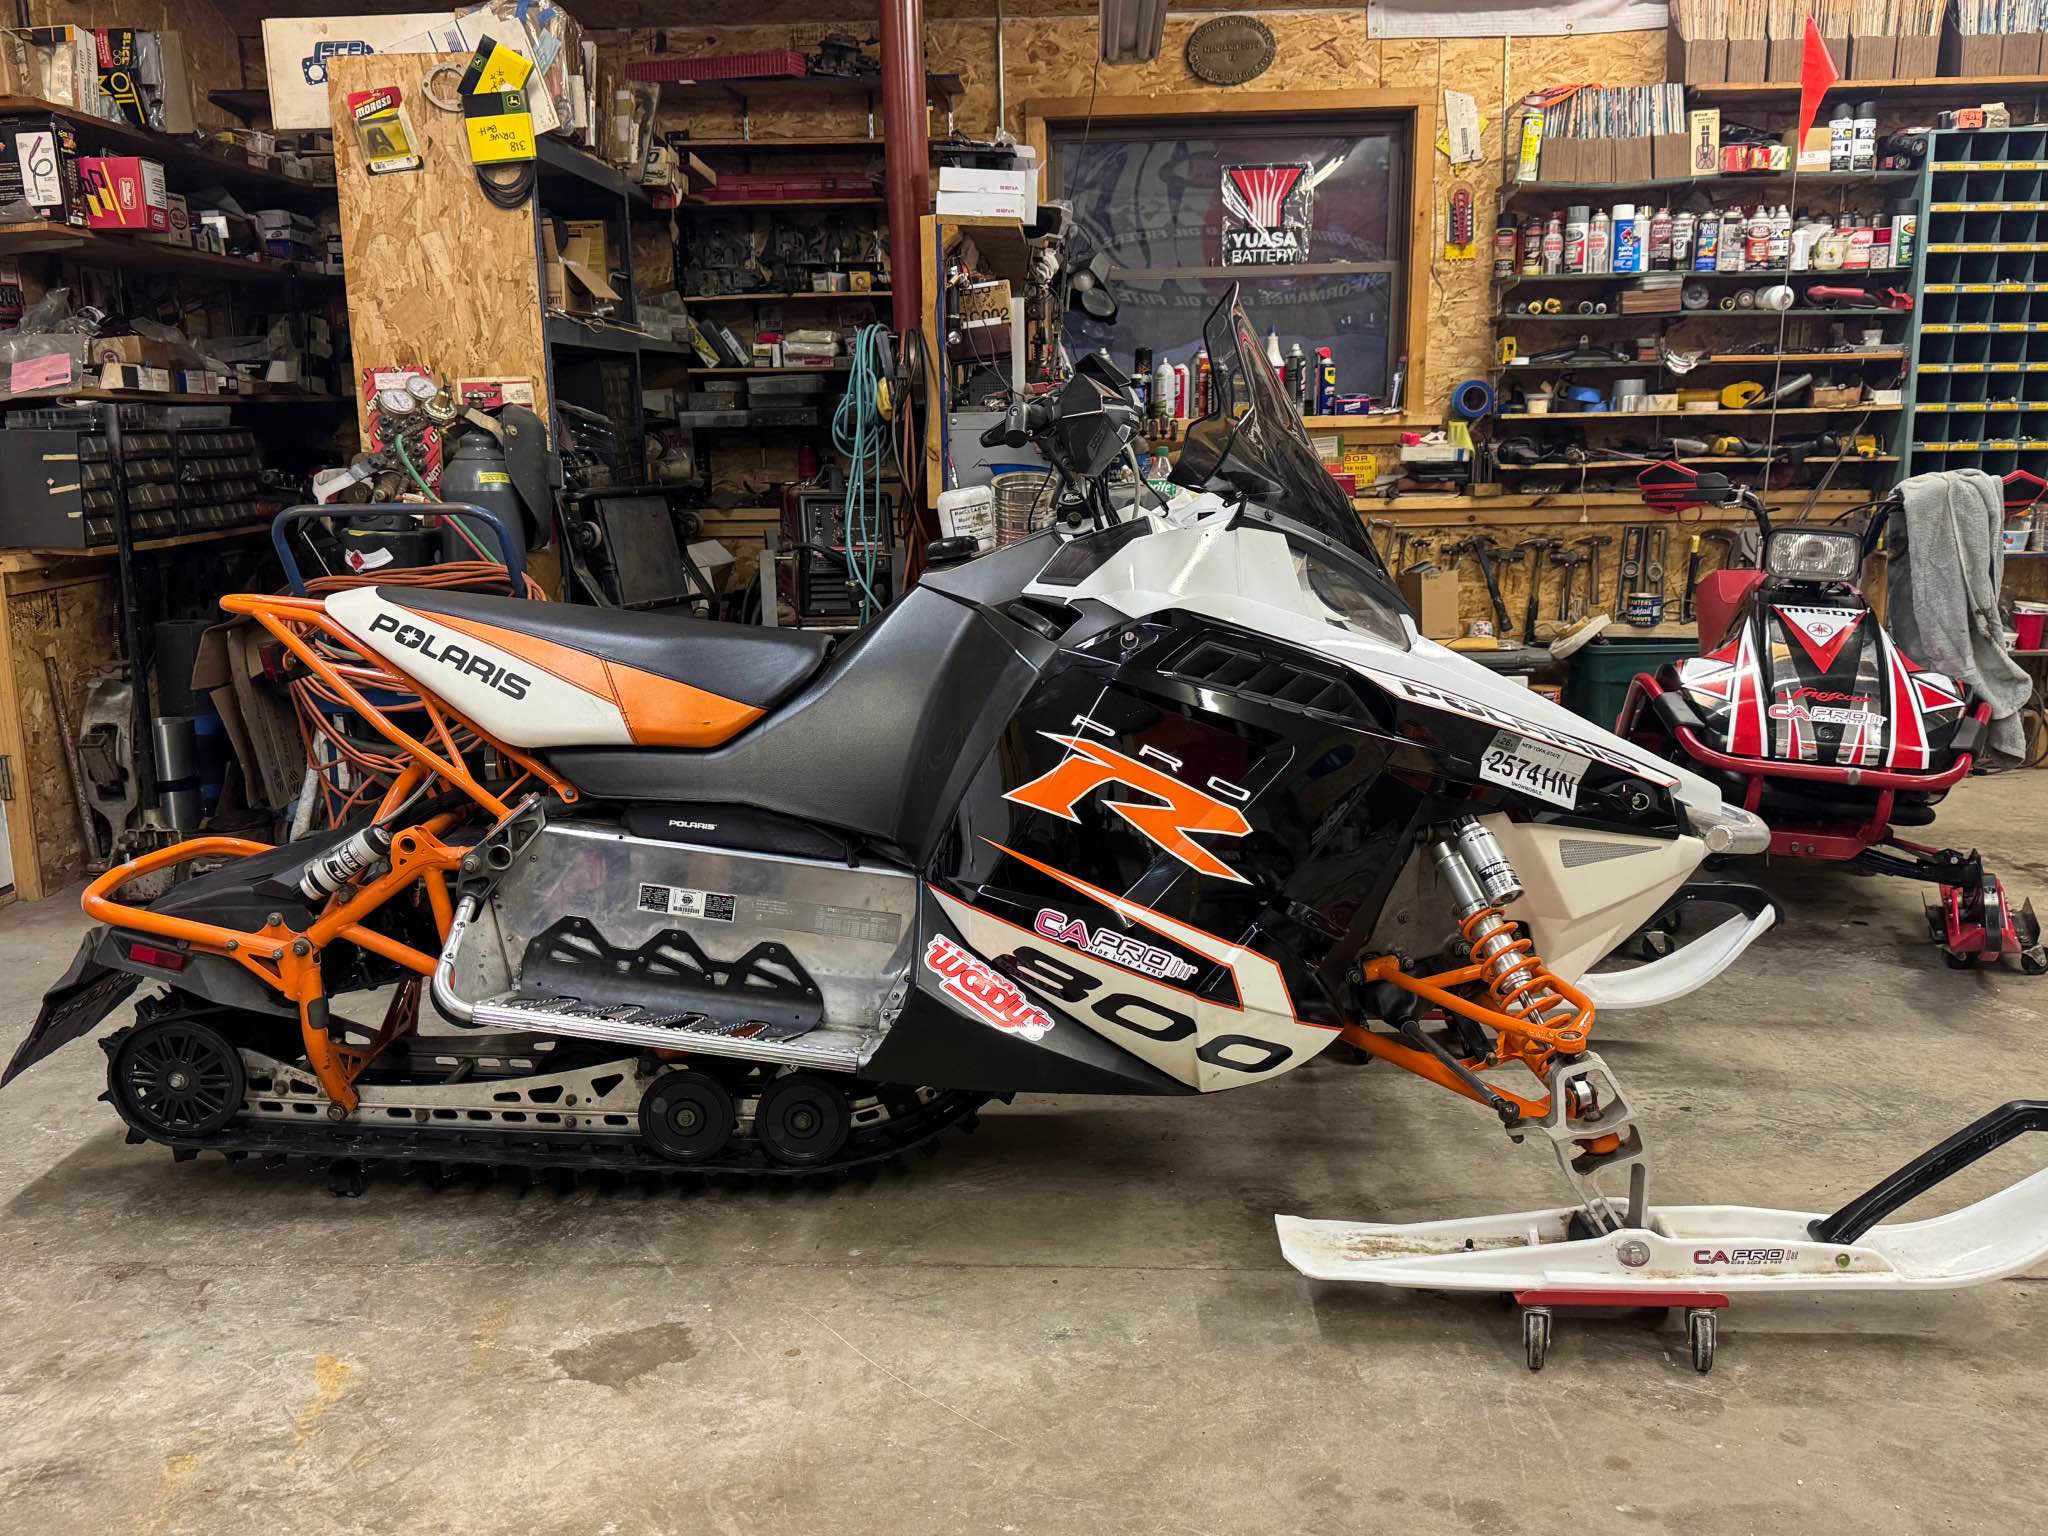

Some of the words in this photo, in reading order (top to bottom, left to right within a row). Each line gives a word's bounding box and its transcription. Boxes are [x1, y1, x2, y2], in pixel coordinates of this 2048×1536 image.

[355, 94, 392, 118] MOROSO
[488, 131, 516, 142] DRIVE
[1860, 128, 1875, 138] 2X
[509, 139, 527, 152] 318
[1231, 231, 1298, 249] YUASA
[1231, 249, 1297, 263] BATTERY
[1779, 606, 1861, 617] MASON
[368, 613, 532, 701] POLARIS
[1812, 706, 1868, 721] PRO
[1399, 680, 1641, 773] POLARIS
[1070, 714, 1251, 802] PRO
[1487, 750, 1576, 799] 2574HN
[669, 819, 717, 830] POLARIS
[1091, 929, 1172, 971] PRO
[935, 937, 1014, 989] TEAM
[1088, 945, 1109, 958] RIDE
[1112, 954, 1132, 966] LIKE
[1145, 966, 1163, 977] PRO
[991, 945, 1293, 1073] 800
[1731, 1249, 1784, 1261] PRO
